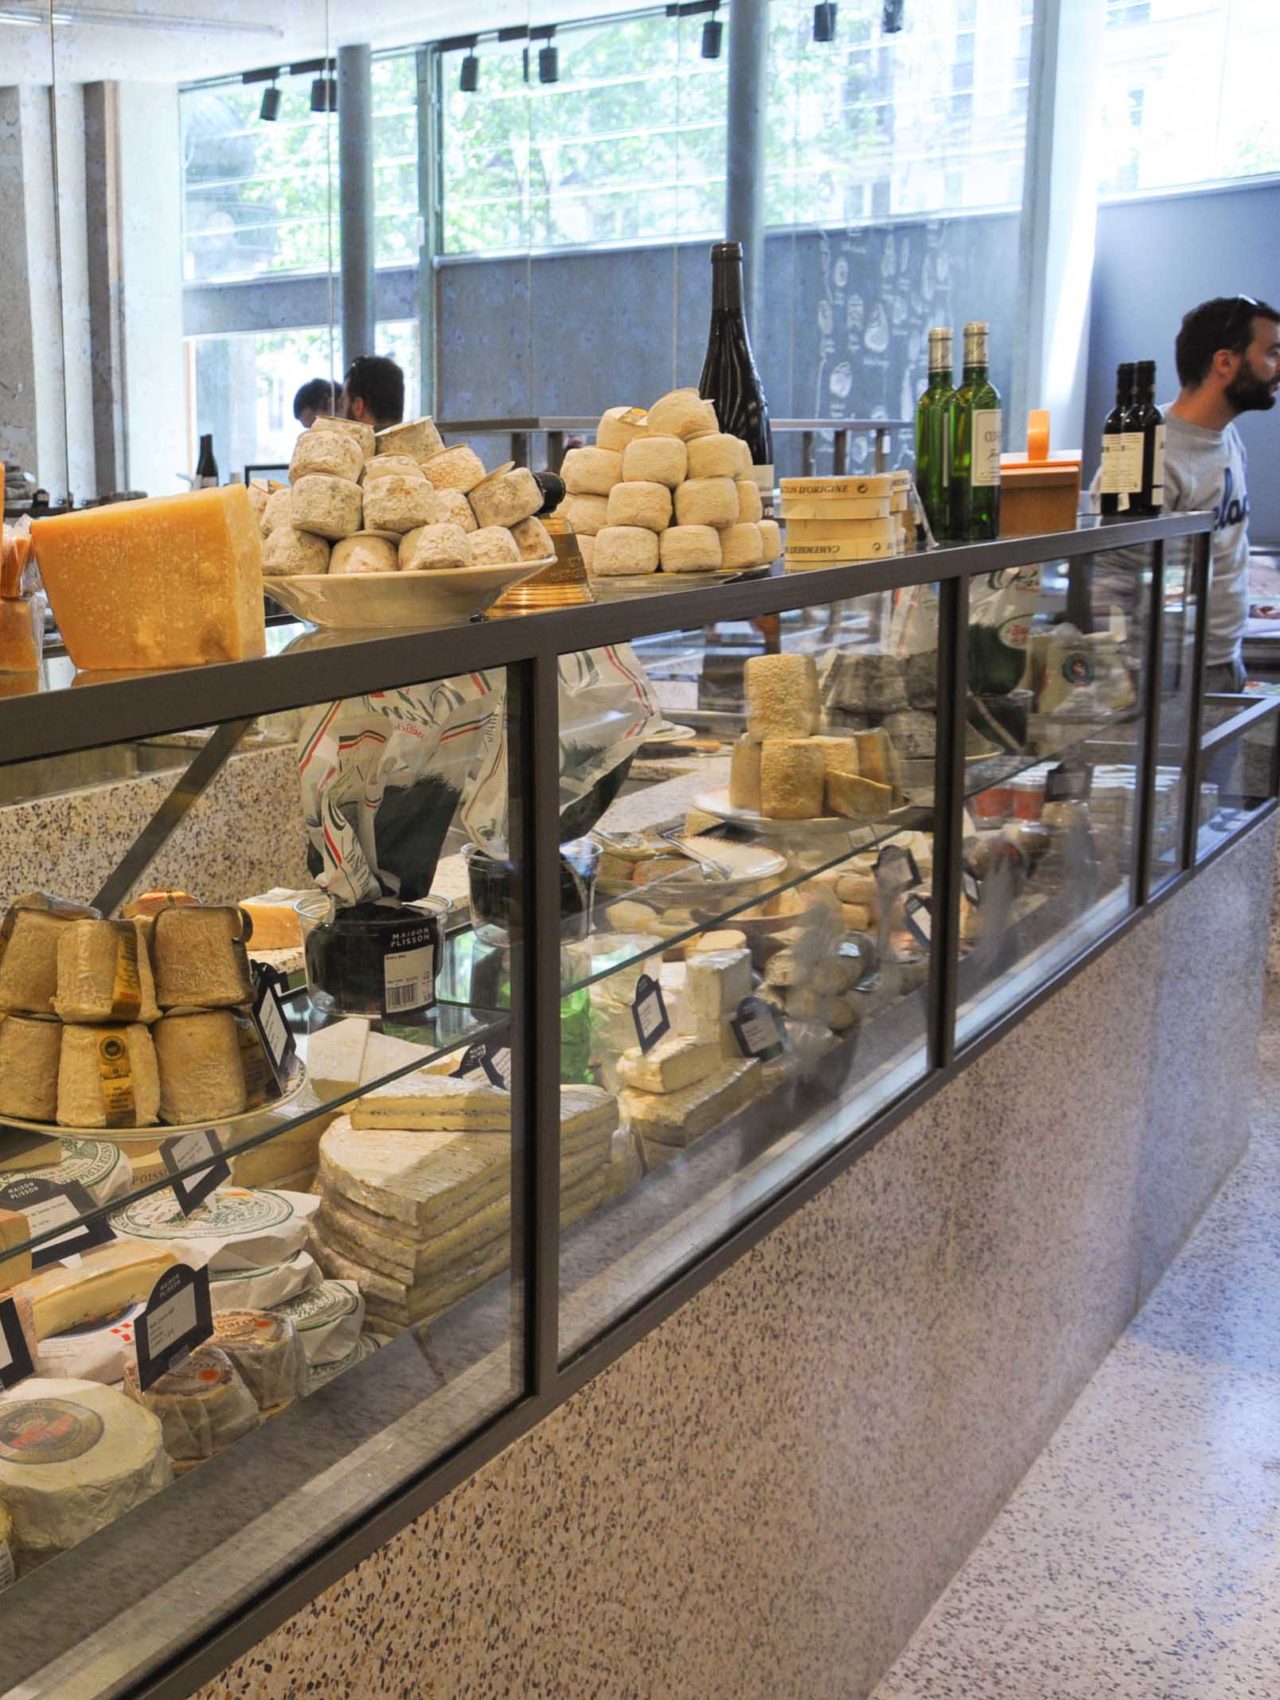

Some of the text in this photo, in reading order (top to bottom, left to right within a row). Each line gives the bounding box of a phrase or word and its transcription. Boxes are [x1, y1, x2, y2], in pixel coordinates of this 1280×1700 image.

[390, 934, 431, 947] PLISSON
[392, 928, 429, 940] MAISON
[7, 1181, 35, 1194] MAISON
[10, 1186, 39, 1200] PLISSON
